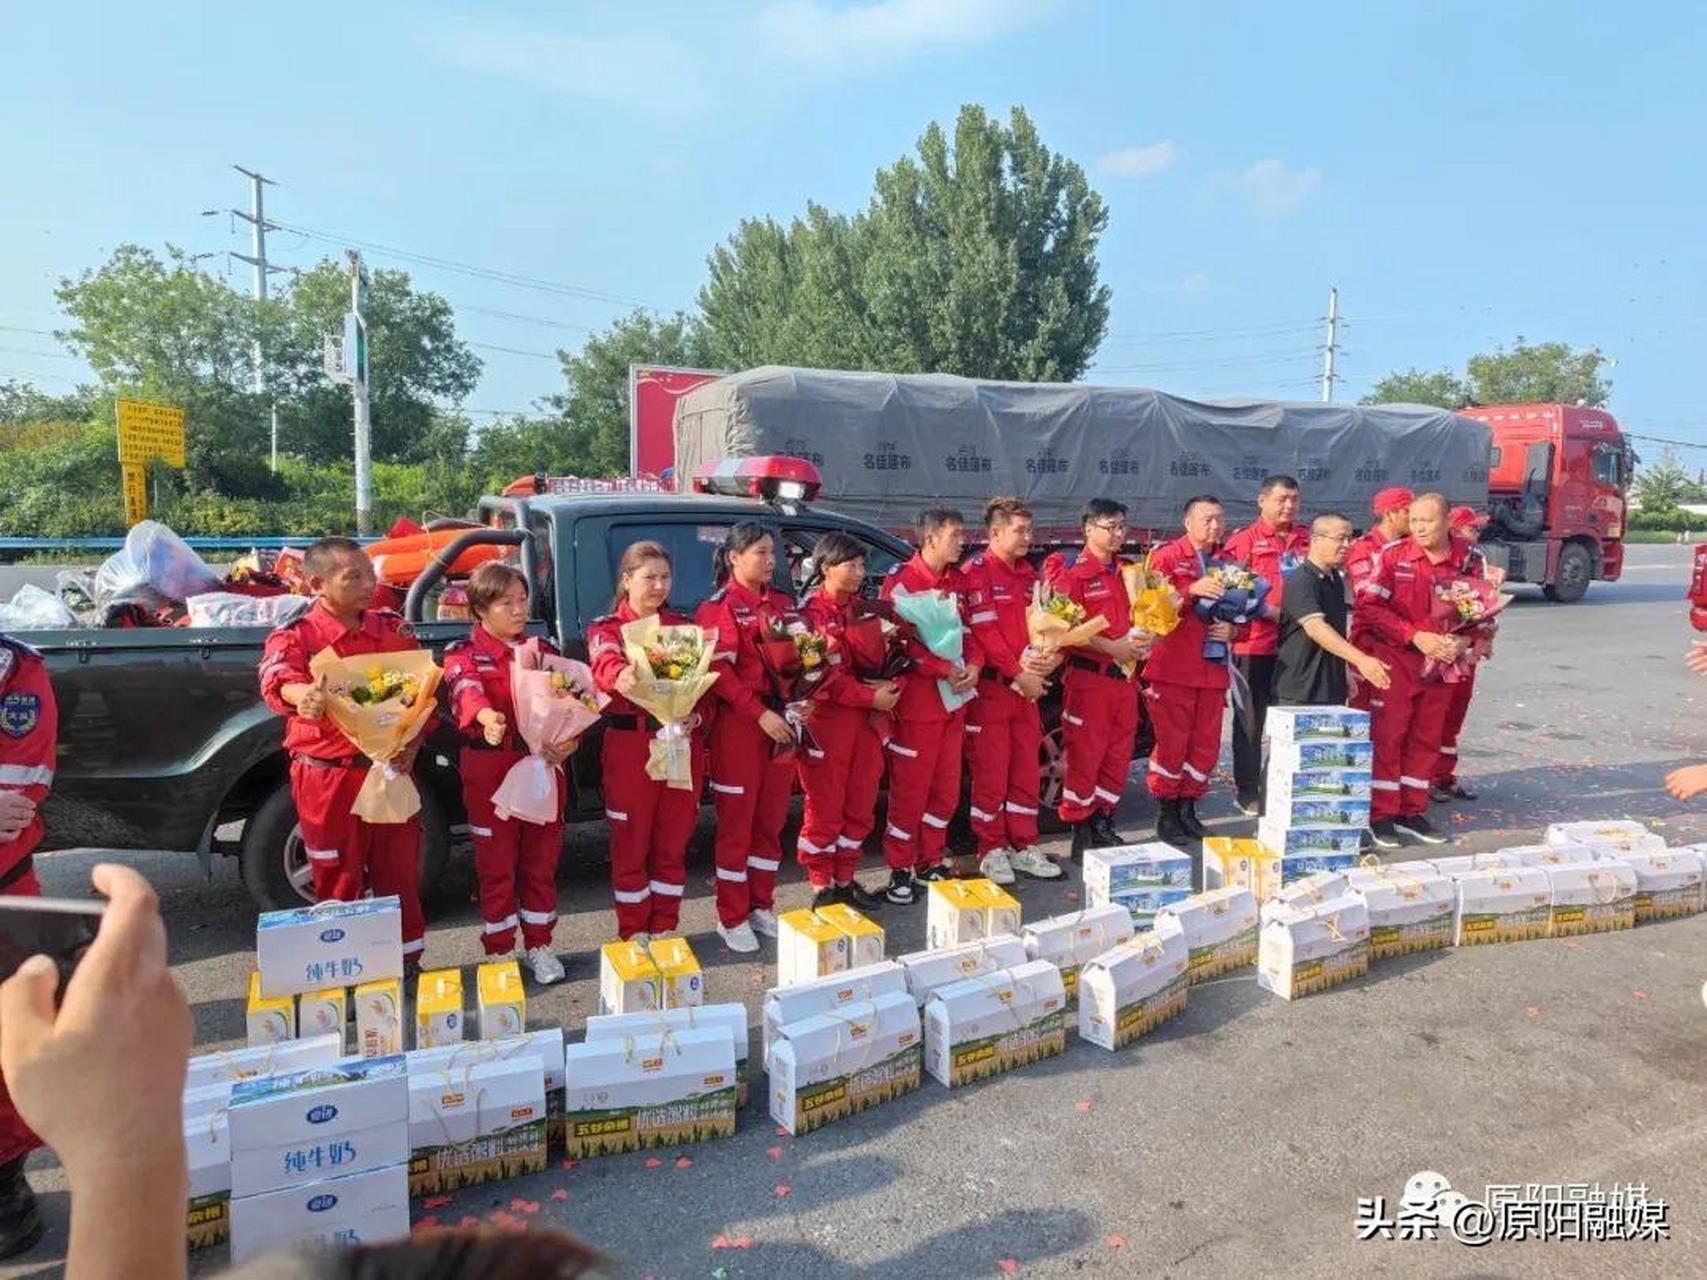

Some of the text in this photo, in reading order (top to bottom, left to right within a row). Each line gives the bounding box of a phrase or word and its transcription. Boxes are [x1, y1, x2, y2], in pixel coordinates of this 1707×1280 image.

[305, 957, 363, 982] 纯牛奶
[284, 1141, 356, 1174] 纯牛奶
